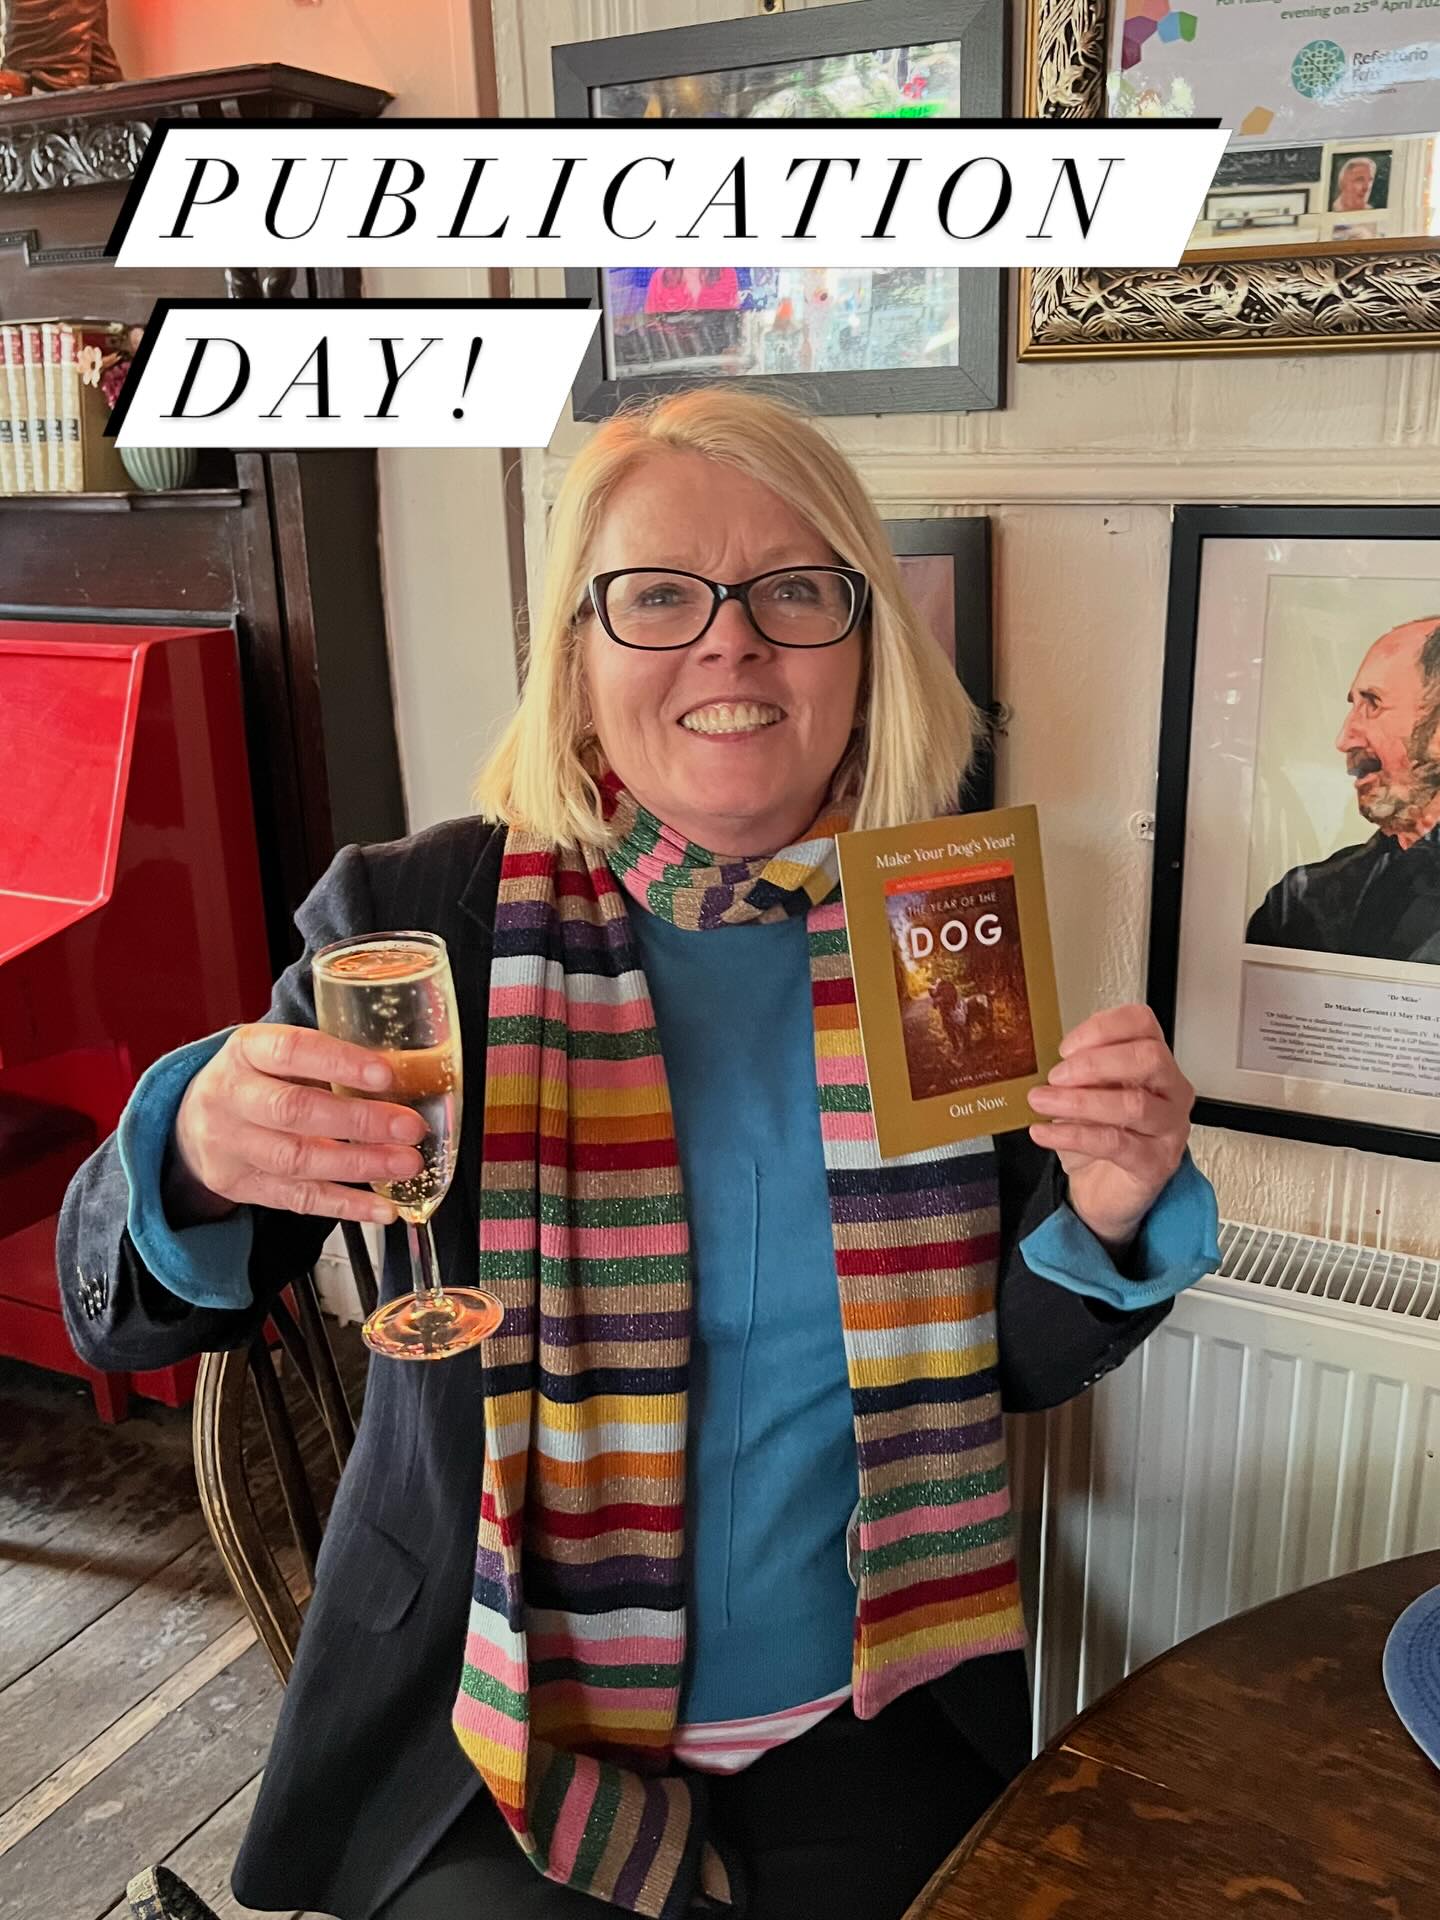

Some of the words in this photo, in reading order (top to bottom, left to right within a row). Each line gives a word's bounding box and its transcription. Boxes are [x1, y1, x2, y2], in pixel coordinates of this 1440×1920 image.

[1281, 5, 1330, 19] evening
[1333, 5, 1350, 15] on
[1382, 0, 1412, 13] April
[876, 851, 911, 869] Make
[914, 847, 945, 862] Your
[947, 840, 982, 858] Dog's
[983, 833, 1016, 851] Year!
[907, 903, 926, 916] THE
[929, 899, 957, 912] YEAR
[960, 896, 975, 907] OF
[978, 891, 997, 904] THE
[910, 913, 1002, 959] DOG
[949, 1102, 974, 1118] Out
[976, 1096, 1008, 1112] Now.
